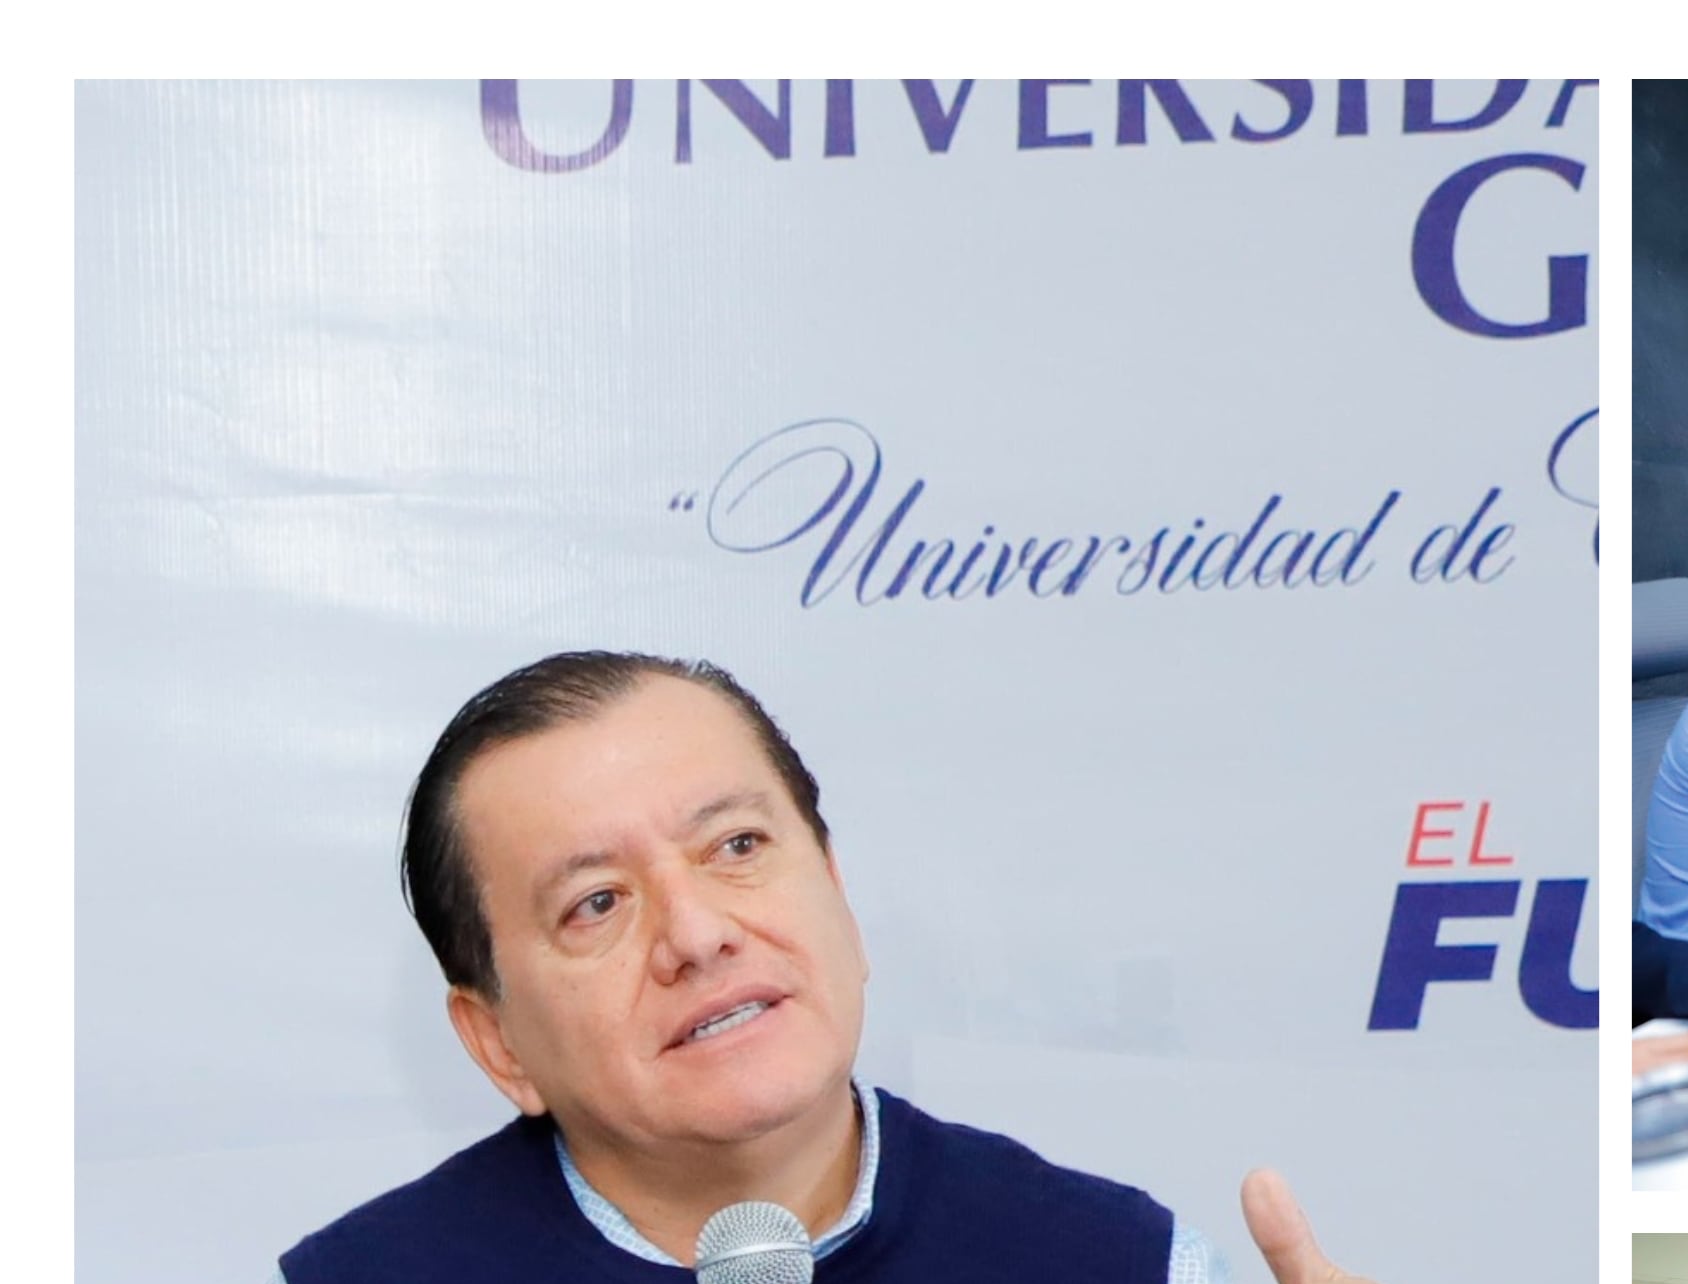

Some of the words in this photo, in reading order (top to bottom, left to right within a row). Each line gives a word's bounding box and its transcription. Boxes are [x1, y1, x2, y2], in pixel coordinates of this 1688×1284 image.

[1410, 487, 1516, 585] de
[1406, 800, 1514, 867] EL
[1367, 877, 1599, 1030] FU
